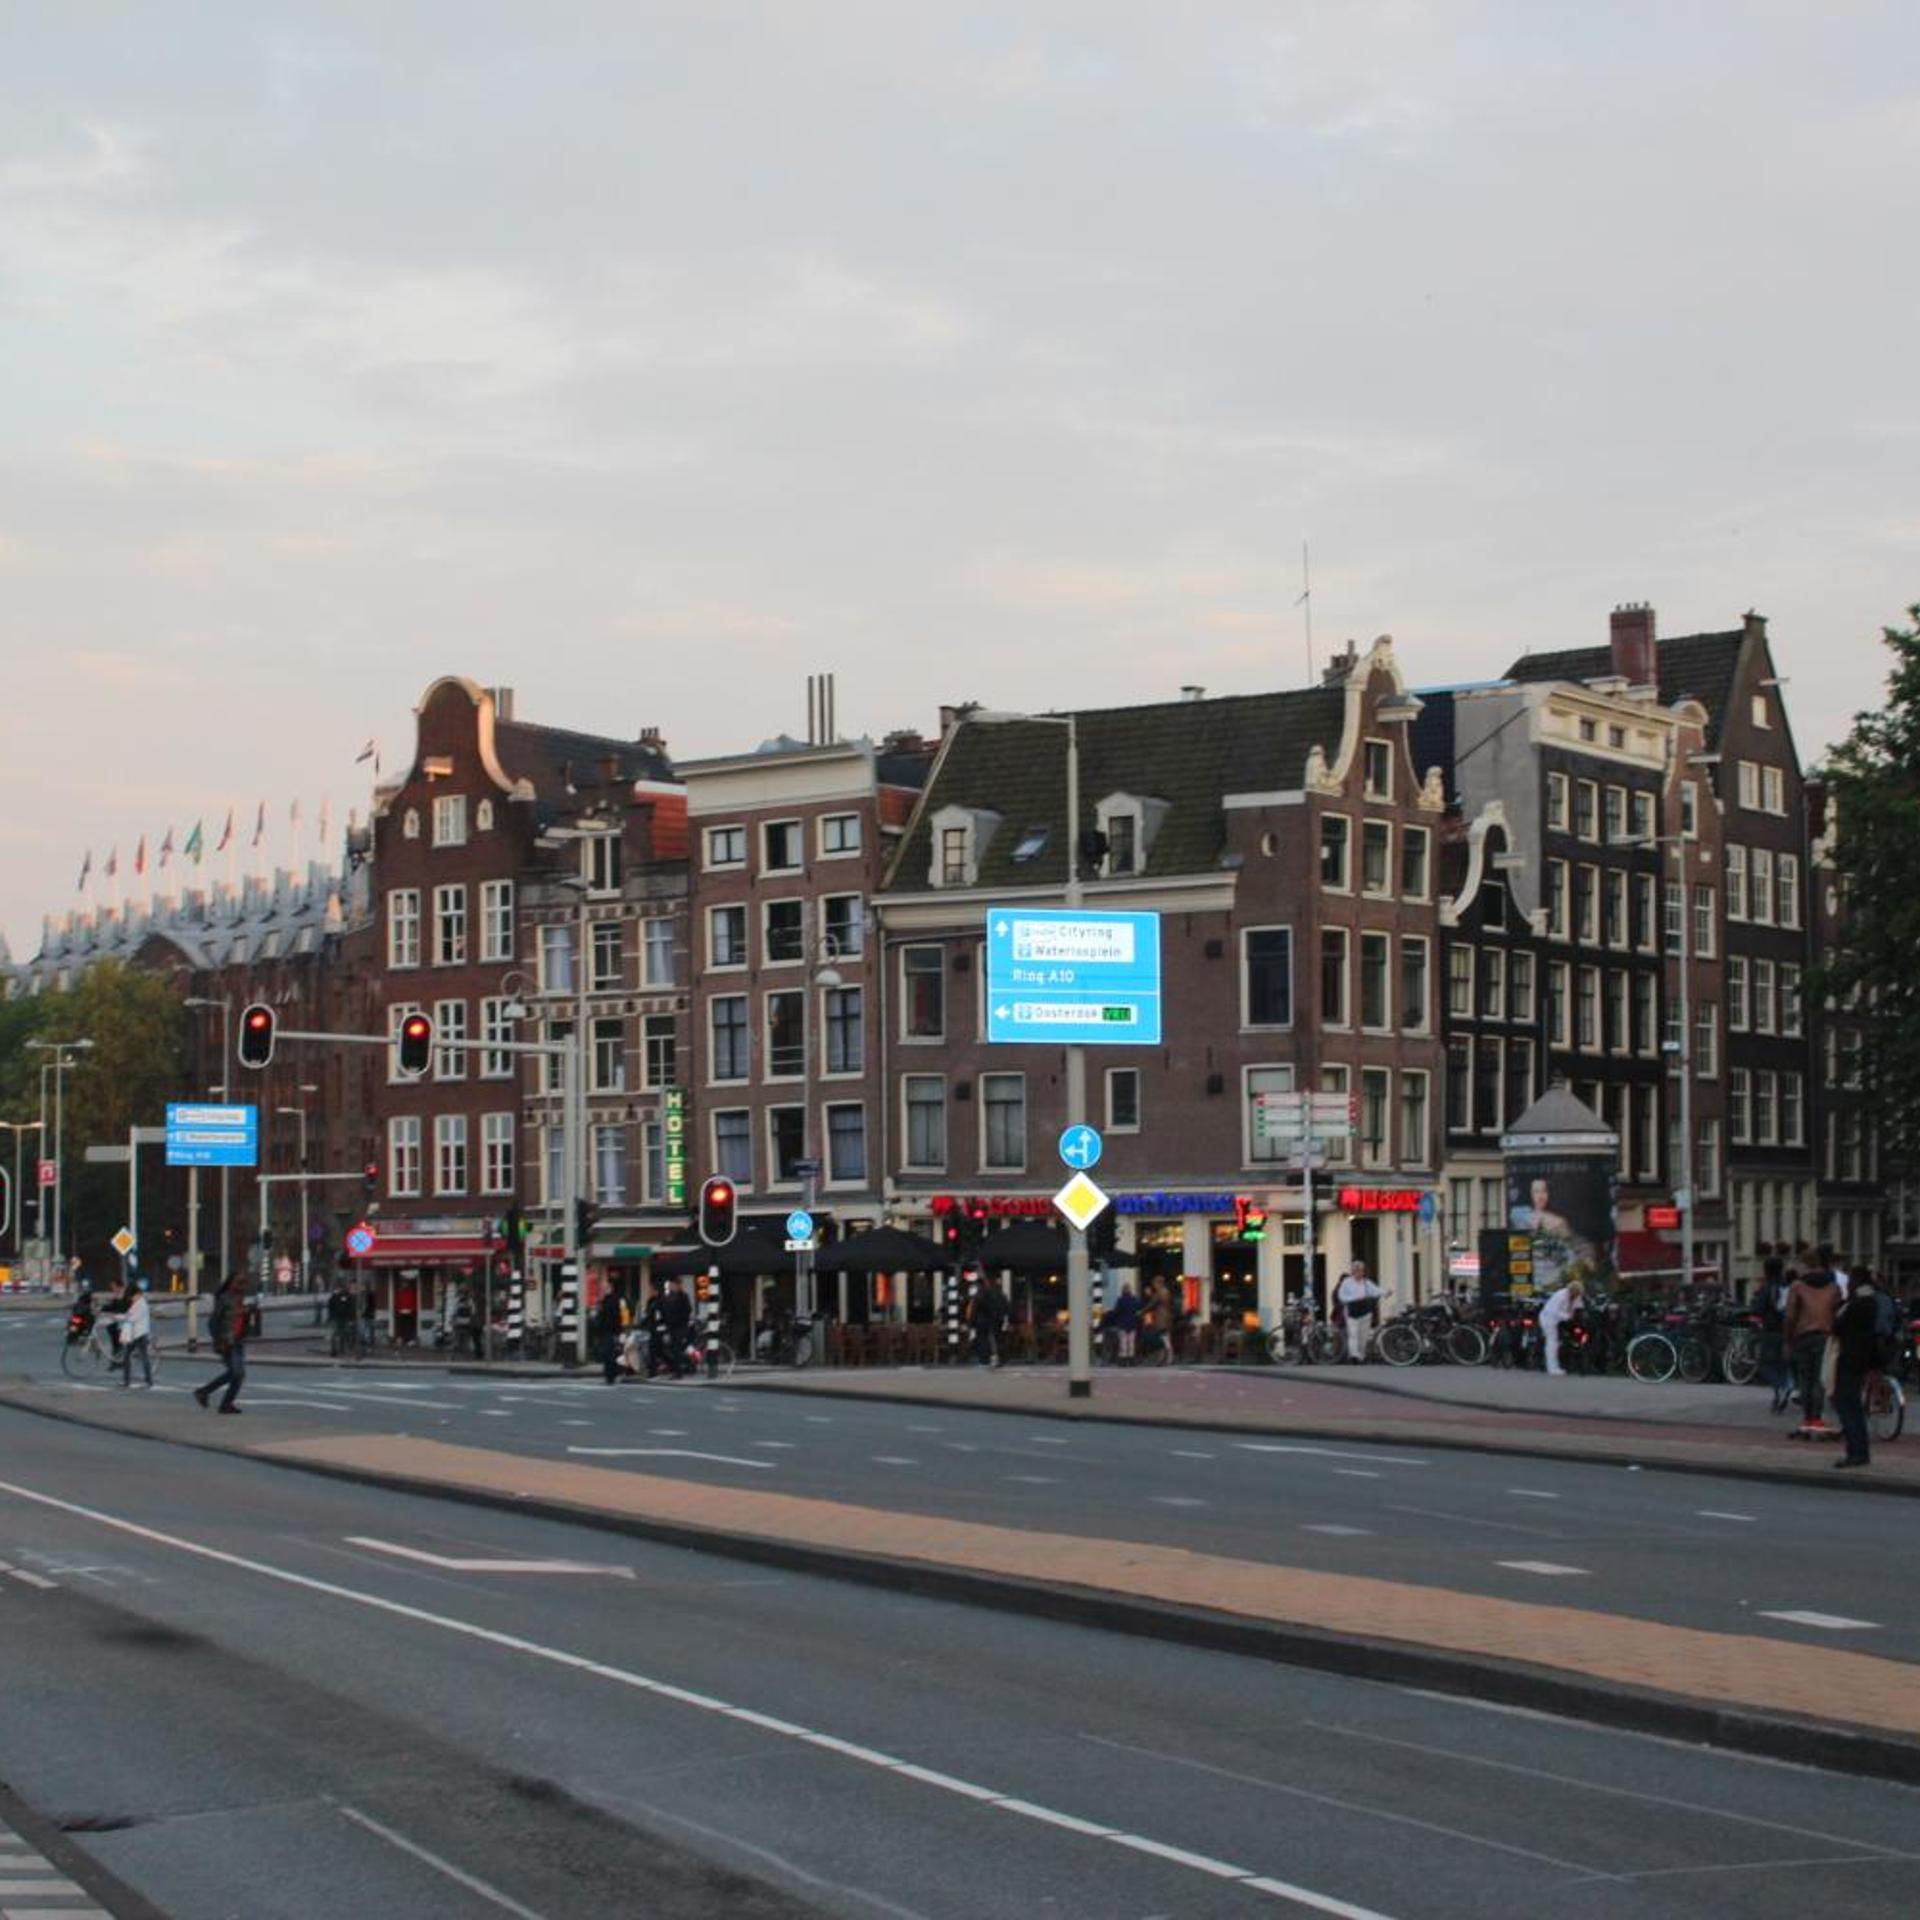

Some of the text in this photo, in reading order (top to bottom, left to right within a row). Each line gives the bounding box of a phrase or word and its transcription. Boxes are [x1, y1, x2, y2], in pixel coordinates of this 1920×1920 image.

[1058, 925, 1113, 940] Cityring
[1035, 945, 1122, 958] Waterlooplein
[1013, 968, 1075, 985] Ring A10
[667, 1091, 683, 1203] HOTEL
